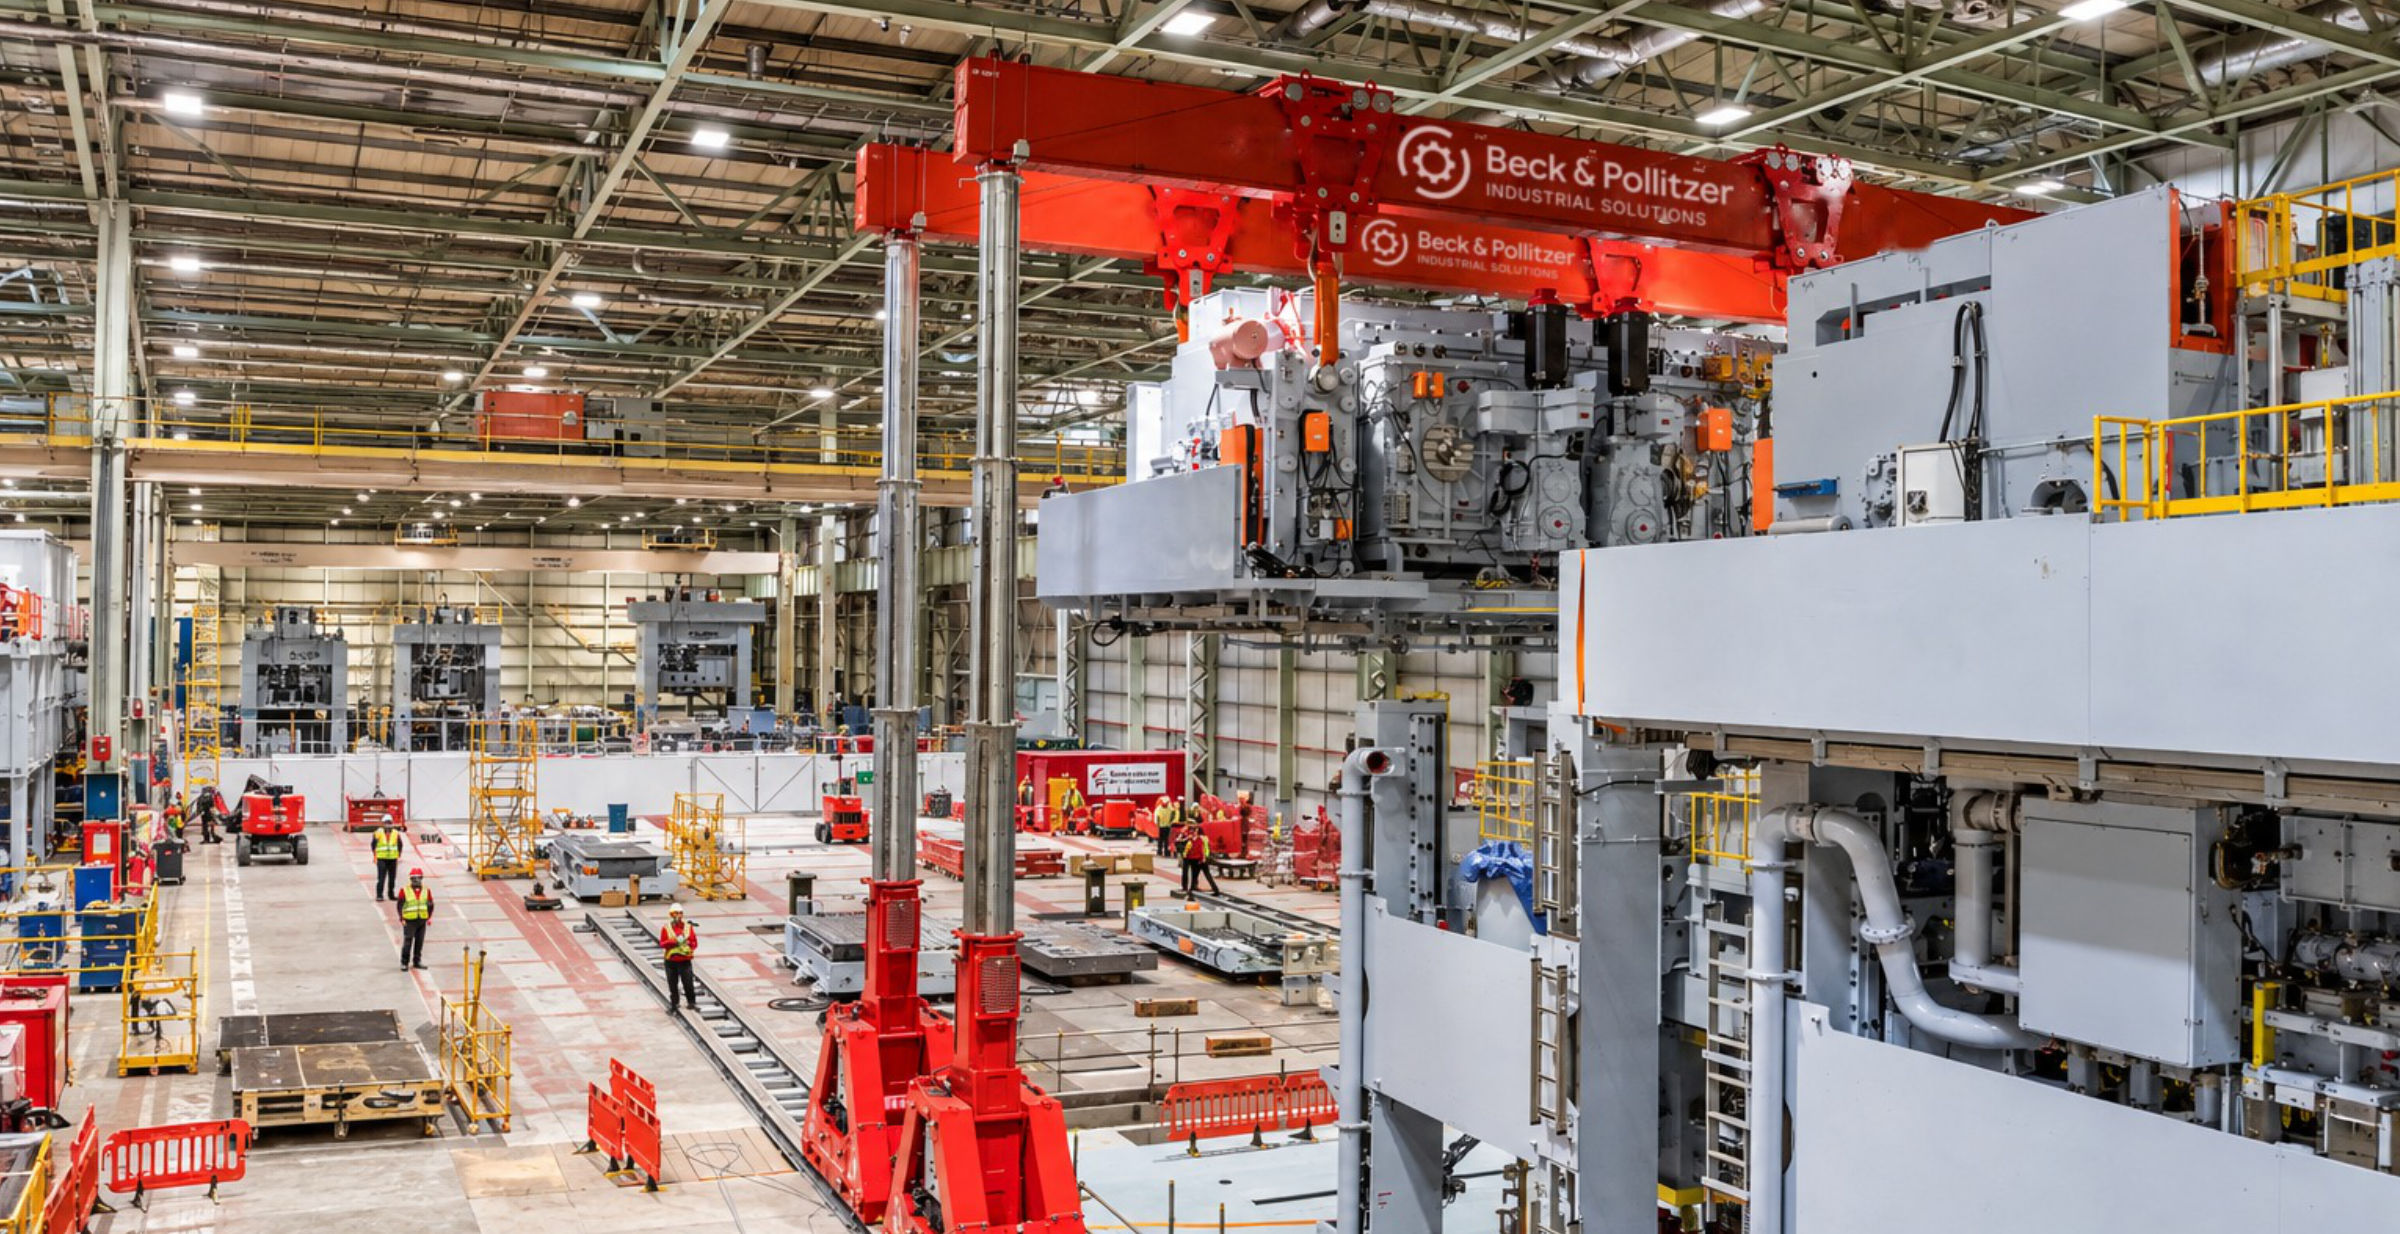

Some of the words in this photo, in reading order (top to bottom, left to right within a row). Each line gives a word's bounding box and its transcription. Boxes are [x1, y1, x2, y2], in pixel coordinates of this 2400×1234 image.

[1487, 144, 1567, 183] Beck
[1573, 157, 1596, 187] &
[1603, 160, 1734, 206] Pollitzer
[1486, 181, 1594, 211] INDUSTRIAL
[1601, 198, 1706, 227] SOLUTIONS
[1417, 254, 1487, 272] INDUSTRIAL
[1490, 262, 1559, 280] SOLUTIONS
[1418, 230, 1469, 254] Beck
[1473, 236, 1488, 256] &
[1492, 239, 1576, 266] Pollitzer
